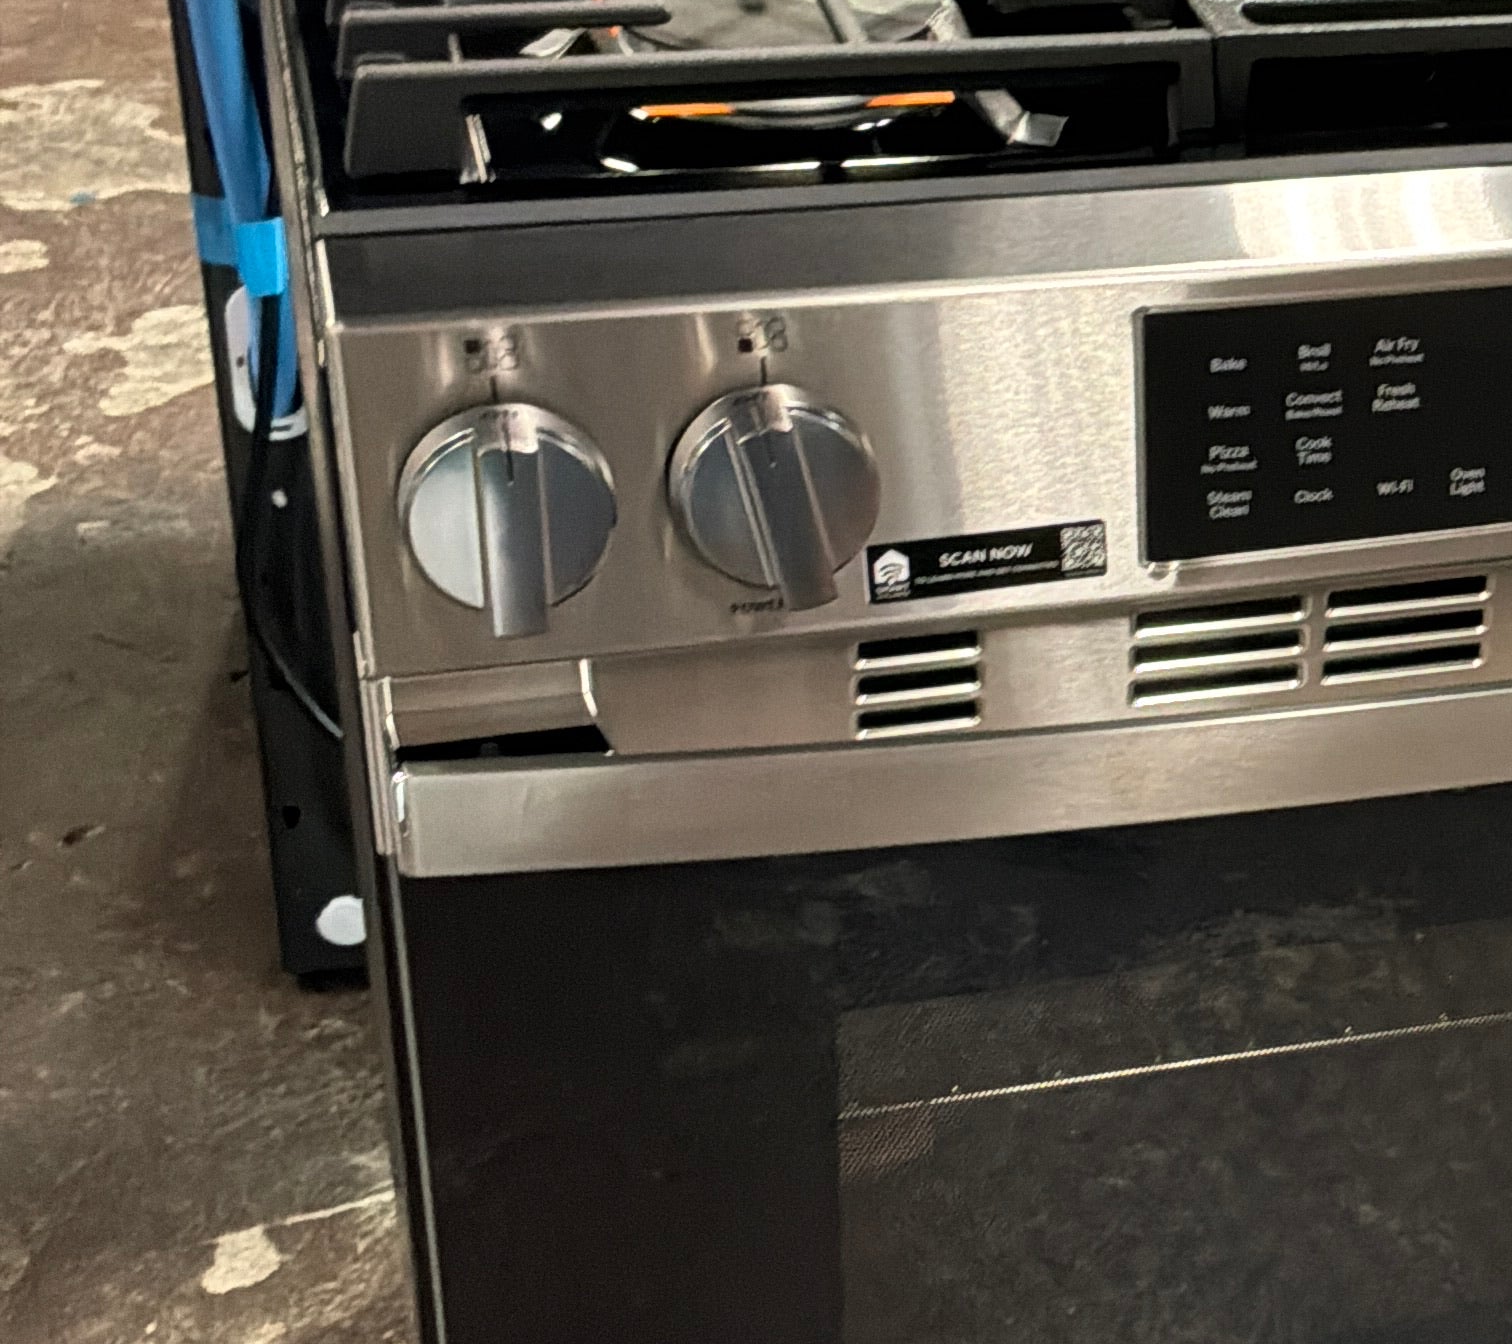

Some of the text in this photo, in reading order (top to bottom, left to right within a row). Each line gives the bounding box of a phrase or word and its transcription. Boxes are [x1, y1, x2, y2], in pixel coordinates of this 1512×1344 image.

[1396, 337, 1420, 352] Fry
[1209, 445, 1249, 461] Pizza
[1294, 488, 1334, 504] Clock
[938, 542, 1034, 568] SCAN NOW
